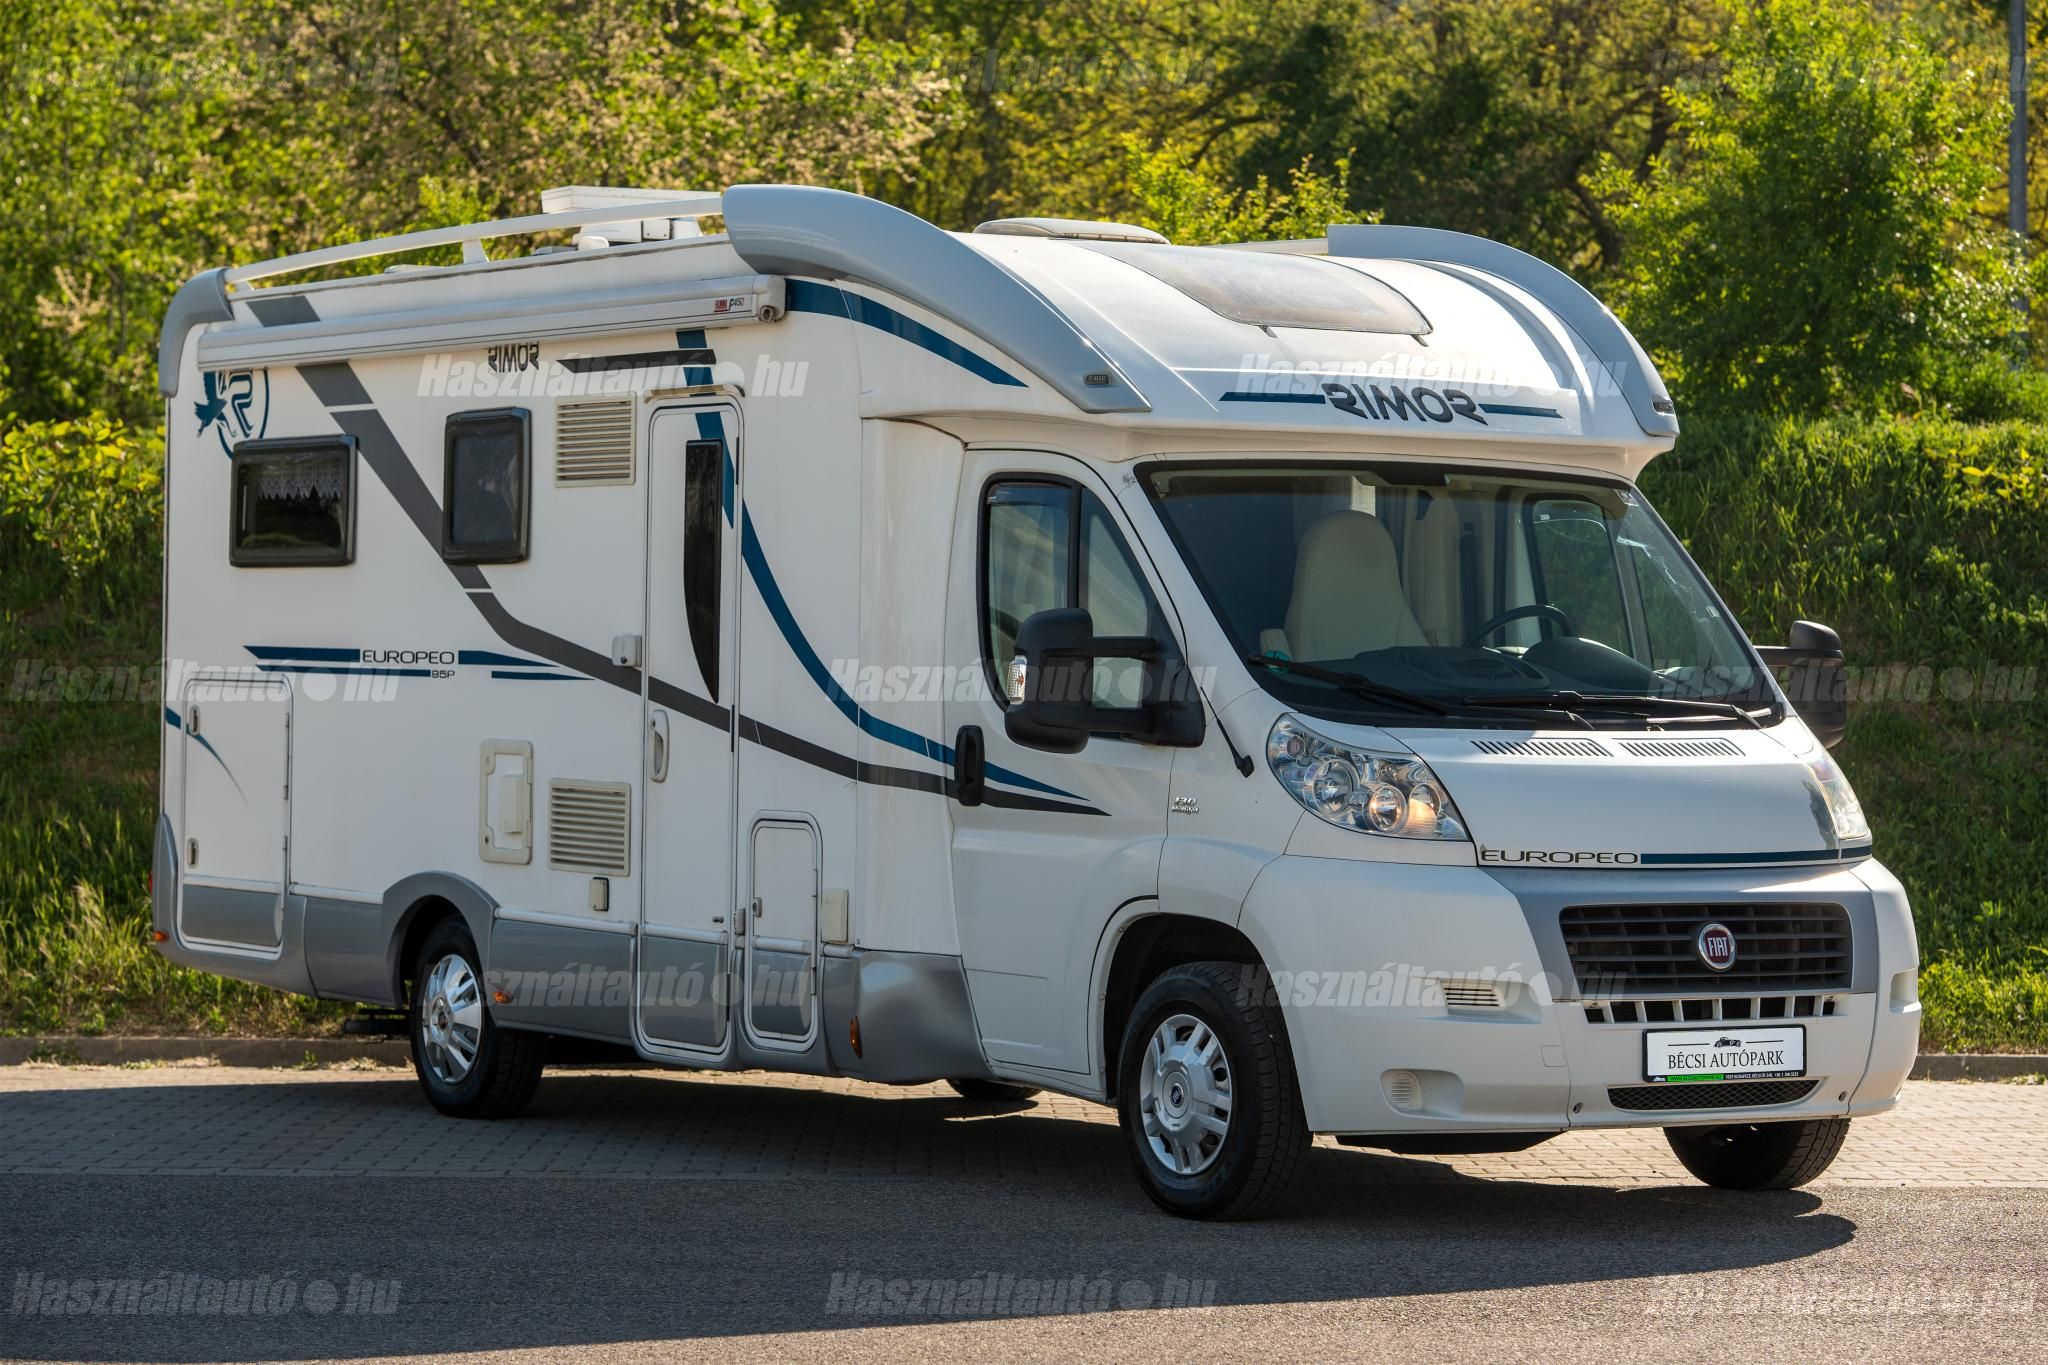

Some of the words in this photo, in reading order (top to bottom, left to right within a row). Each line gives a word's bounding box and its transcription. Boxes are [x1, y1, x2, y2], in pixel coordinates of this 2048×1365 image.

[488, 343, 539, 373] RIMOR
[1321, 383, 1488, 426] RIMOR
[362, 650, 455, 664] EUROPEO
[1481, 849, 1639, 864] EUROPEO
[1707, 936, 1729, 957] FIAT
[1668, 1051, 1706, 1070] BÉCSI
[1710, 1049, 1785, 1068] AUTÓPARK
